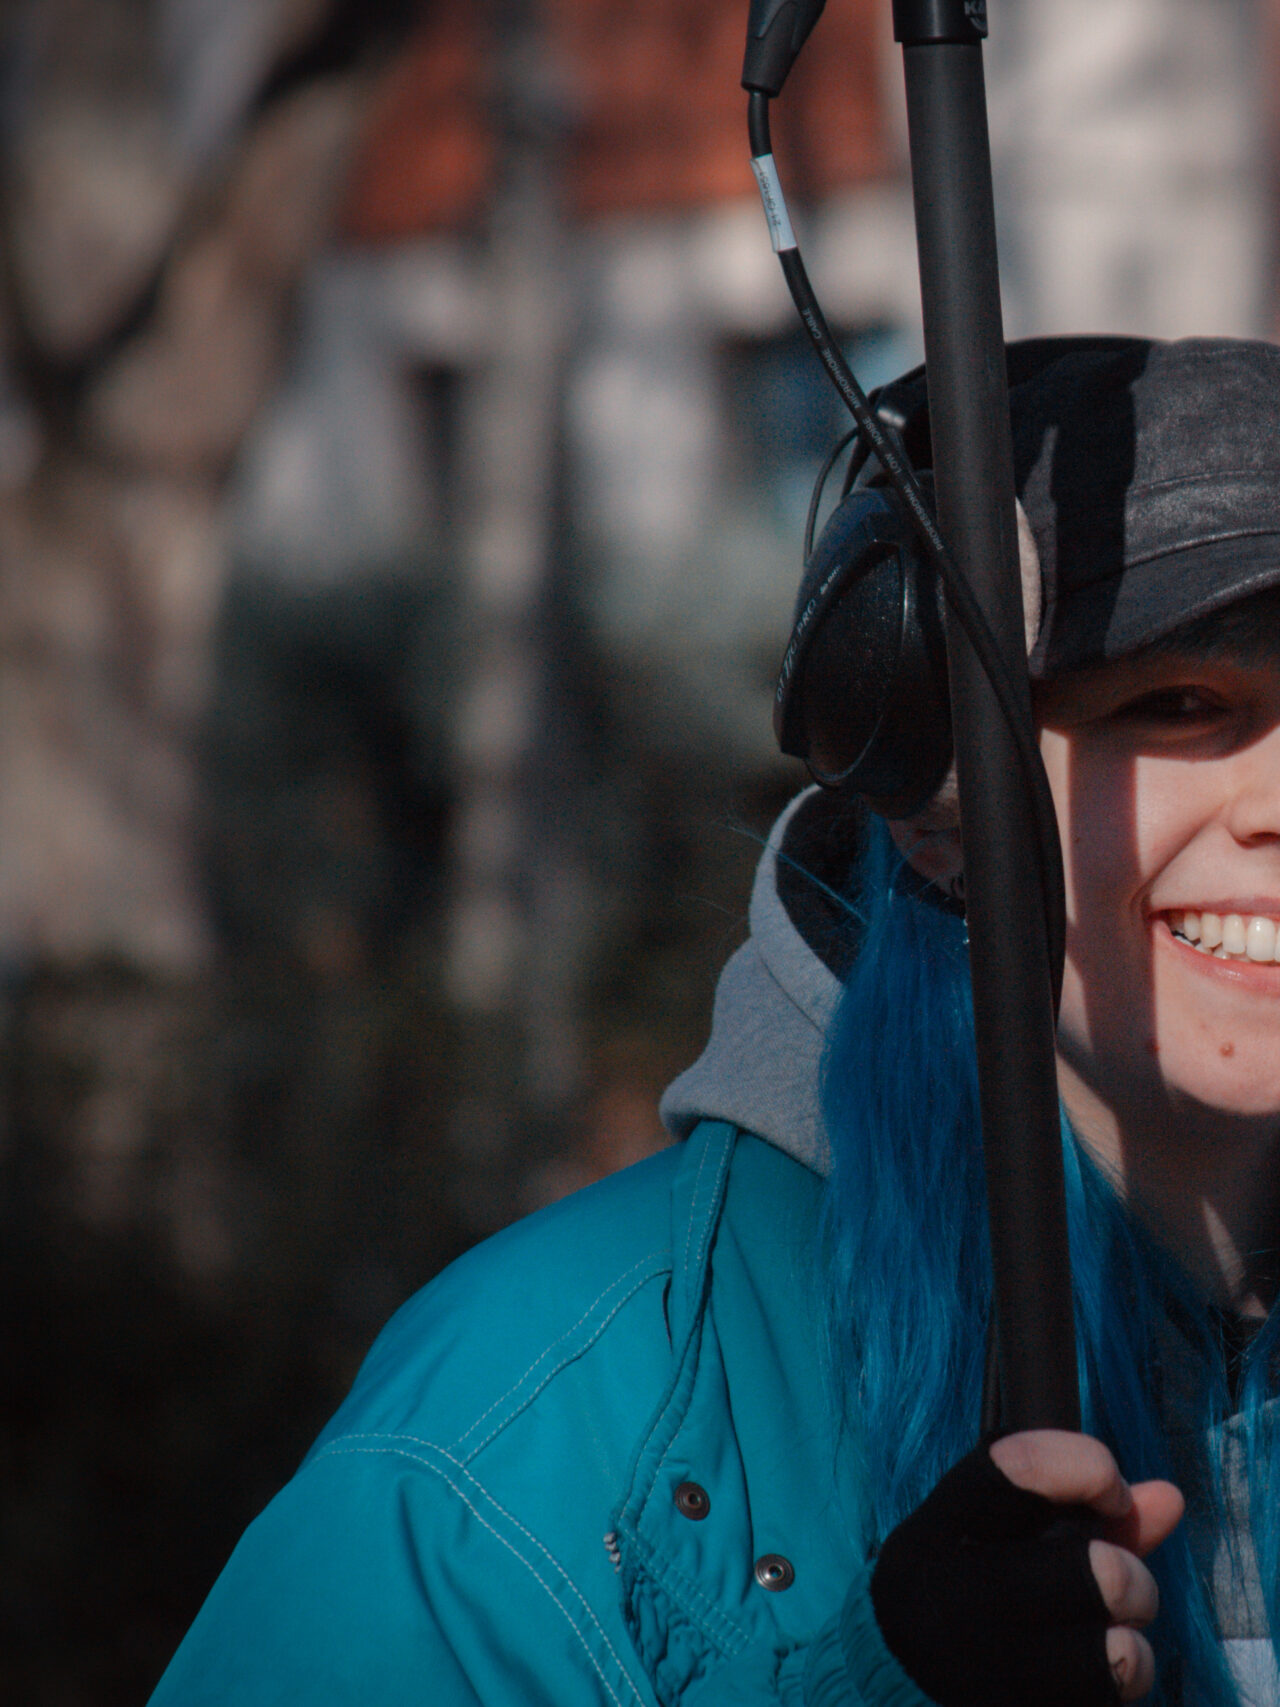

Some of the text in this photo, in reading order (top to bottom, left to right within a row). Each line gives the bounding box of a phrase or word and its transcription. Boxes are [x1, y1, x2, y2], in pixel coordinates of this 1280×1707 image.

[803, 308, 943, 550] PROFESSIONAL LOW NOISE MICROPHONE CABLE
[797, 599, 816, 636] PRO
